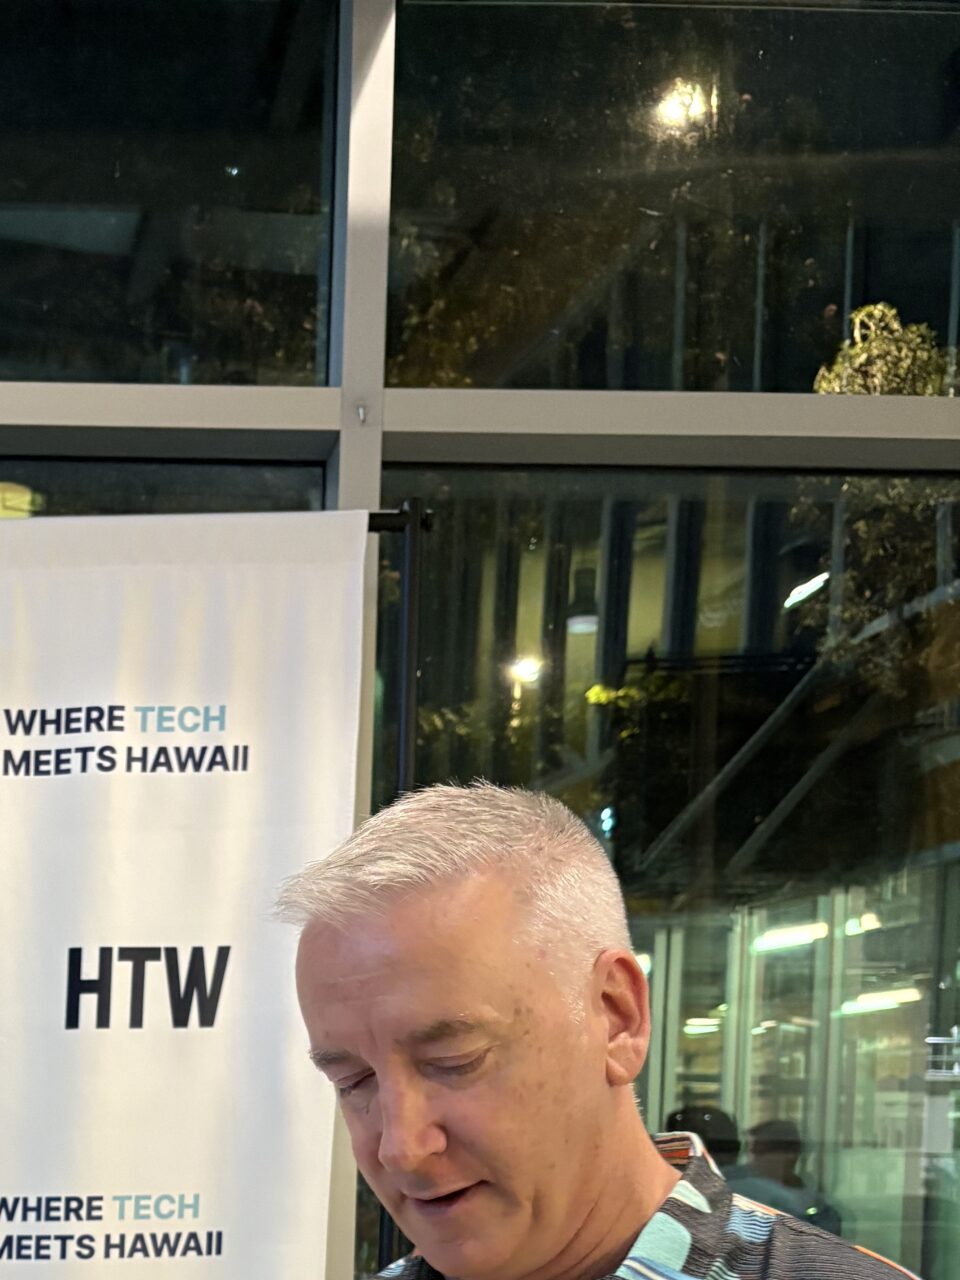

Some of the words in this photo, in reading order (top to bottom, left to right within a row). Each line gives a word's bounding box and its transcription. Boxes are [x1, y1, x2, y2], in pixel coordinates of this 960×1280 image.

[3, 705, 125, 736] WHERE
[134, 705, 227, 734] TECH
[2, 745, 117, 776] MEETS
[125, 745, 249, 773] HAWAII
[65, 946, 231, 1030] HTW
[112, 1193, 200, 1220] TECH
[104, 1231, 223, 1259] HAWAII
